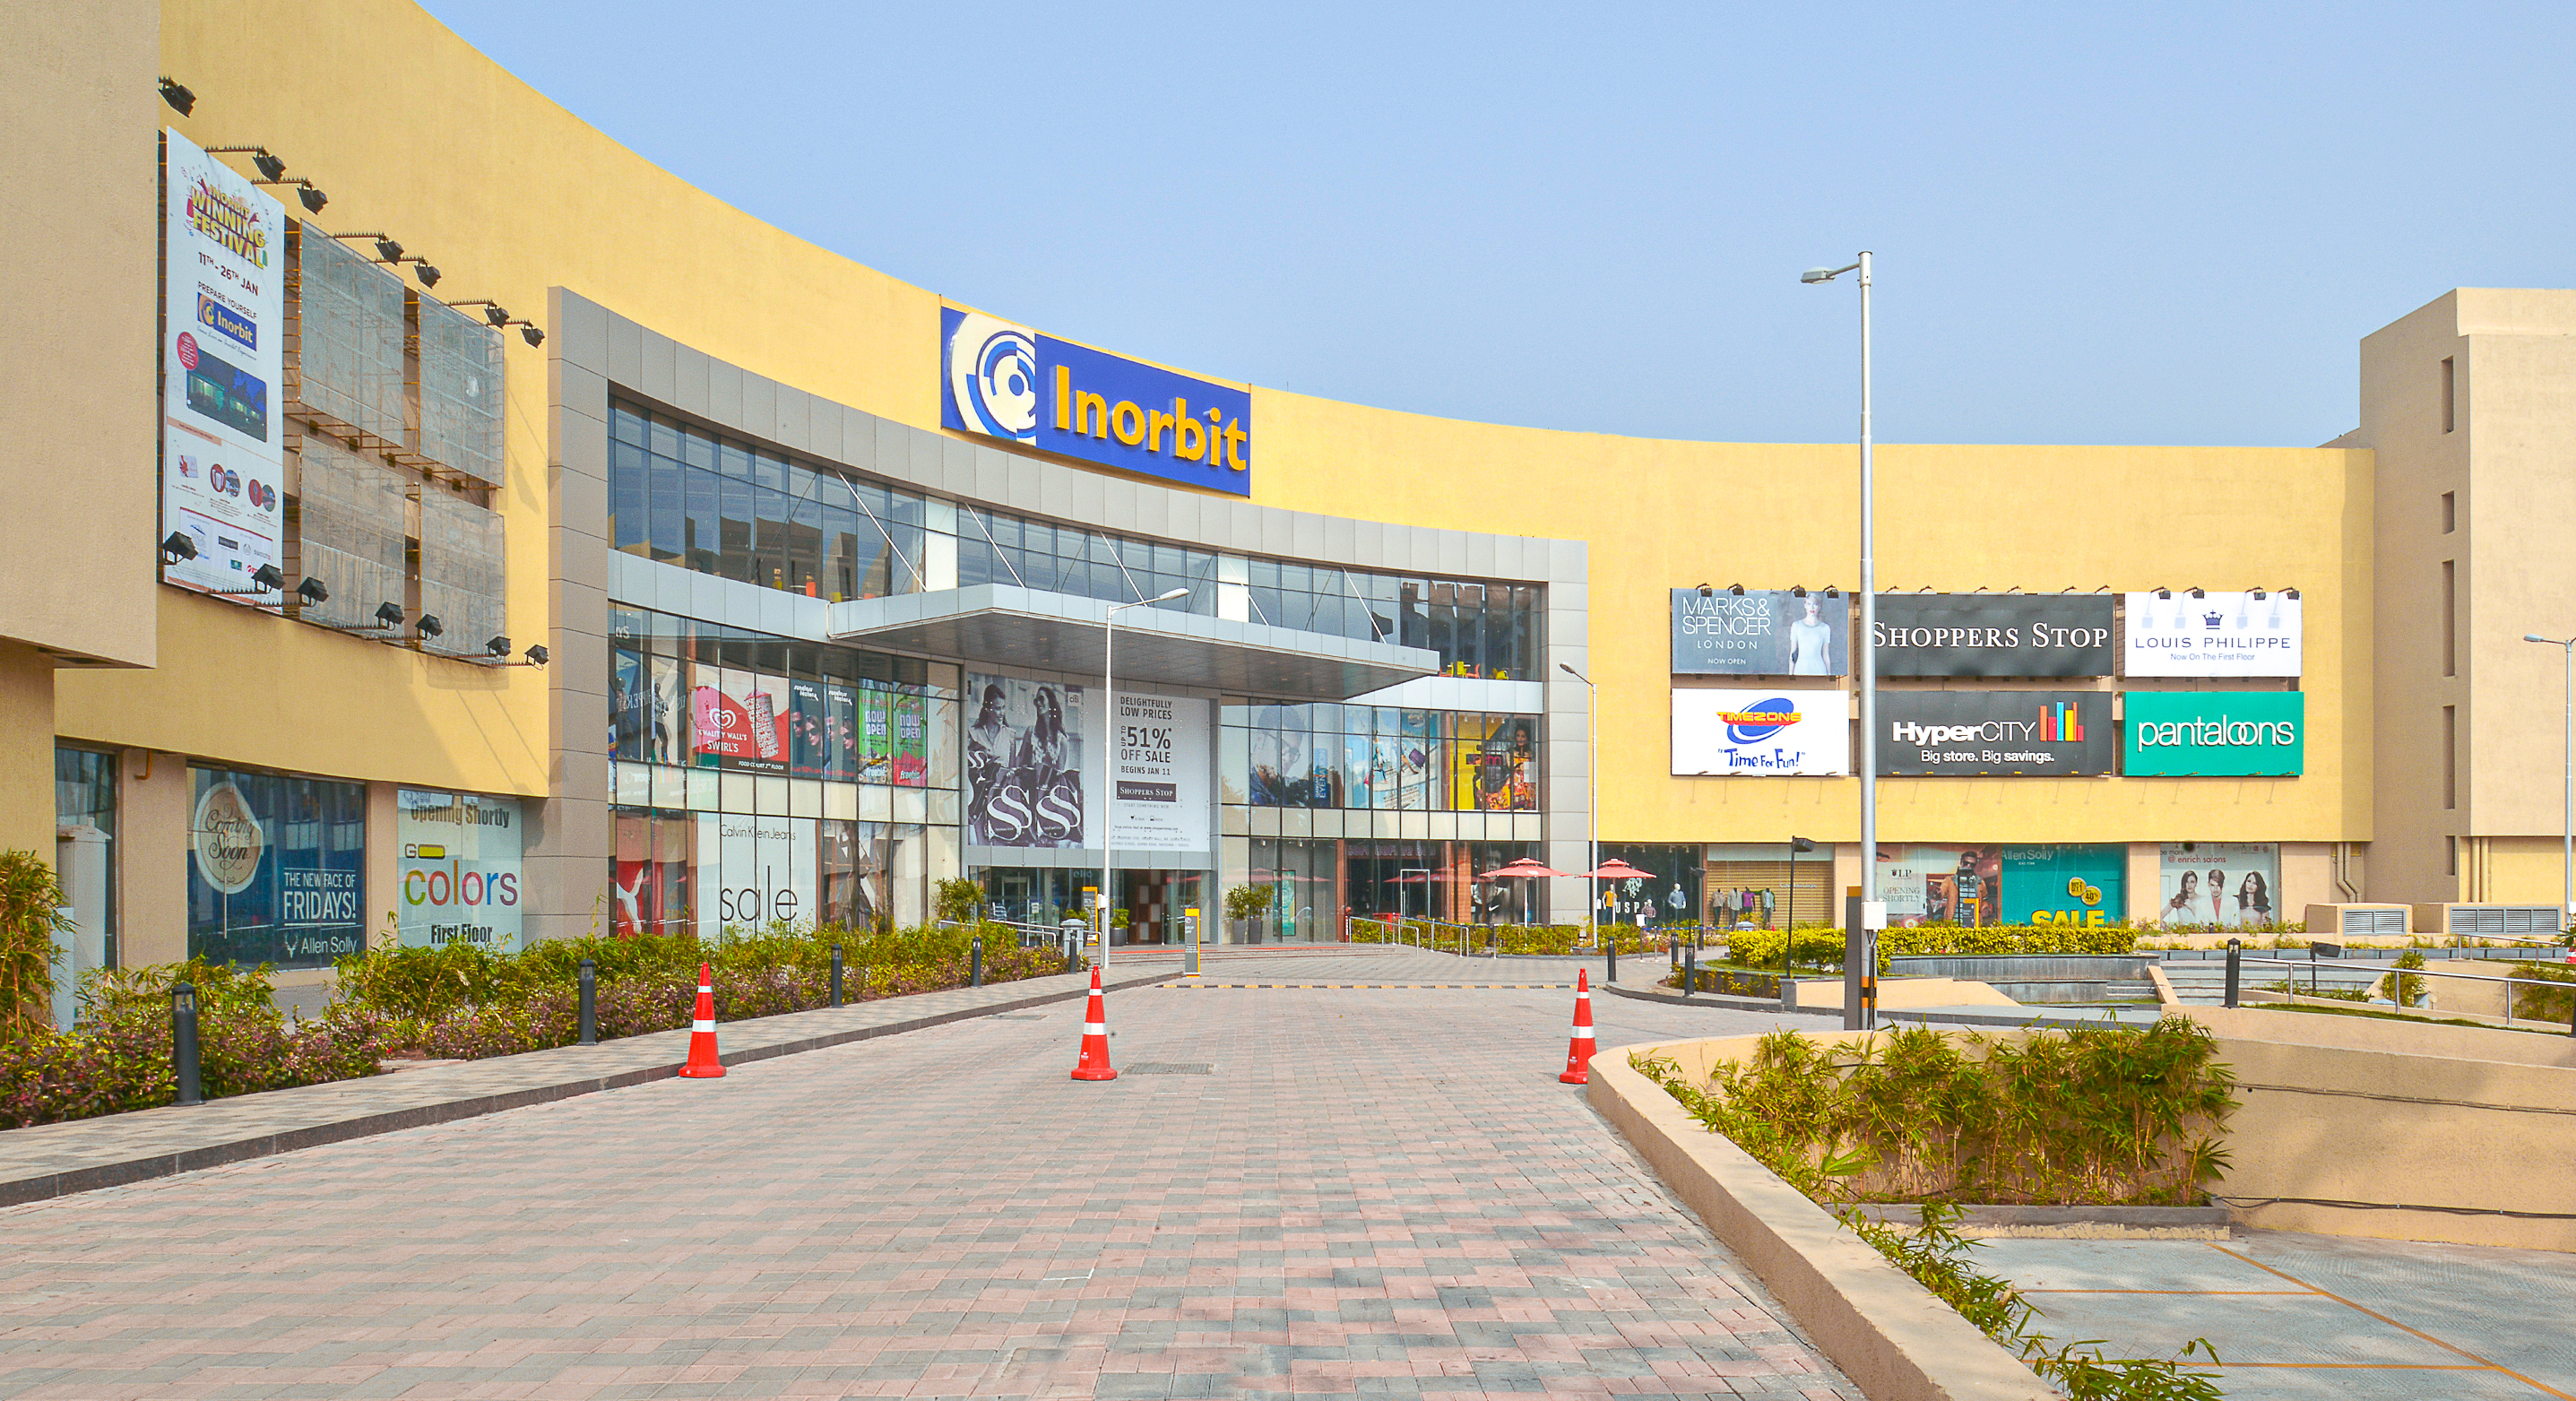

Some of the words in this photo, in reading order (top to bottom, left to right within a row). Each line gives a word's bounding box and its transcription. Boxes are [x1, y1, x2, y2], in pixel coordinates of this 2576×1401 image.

[191, 186, 265, 248] WINNING
[193, 207, 264, 270] FESTIVAL
[198, 252, 214, 265] 11TH
[220, 265, 239, 280] 26TH
[240, 278, 258, 296] JAN
[198, 281, 226, 303] PREPARE
[227, 297, 257, 320] YOURSELF
[217, 310, 253, 343] Inorbit
[1052, 364, 1247, 471] Inorbit
[1682, 616, 1771, 636] SPENCER
[2032, 622, 2108, 648] STOP
[2135, 637, 2192, 648] LOUIS
[2204, 637, 2291, 648] PHILIPPE
[1697, 640, 1758, 650] LONDON
[1120, 696, 1172, 709] DELIGHTFULLY
[1120, 706, 1139, 717] LOW
[1143, 708, 1172, 720] PRICES
[1716, 712, 1802, 723] TIMEZONE
[727, 732, 748, 740] WALL'S
[1120, 725, 1127, 734] TO
[1892, 721, 2036, 746] HyperCITY
[2138, 714, 2295, 753] pantaloons
[707, 740, 739, 753] SWIRL'S
[1120, 736, 1127, 747] UP
[1120, 748, 1141, 761] OFF
[1145, 751, 1171, 763] SALE
[1760, 756, 1775, 767] For
[1921, 750, 1941, 764] Big
[1942, 751, 1979, 762] store.
[1982, 750, 2001, 764] Big
[2003, 751, 2055, 764] savings.
[1120, 765, 1145, 774] BEGINS
[1155, 789, 1173, 797] STOP
[204, 809, 255, 844] Coming
[721, 824, 748, 837] Calvin
[748, 826, 770, 839] Kein
[209, 833, 248, 860] Soon
[2002, 850, 2026, 860] Allen
[2027, 849, 2054, 860] Solly
[2168, 855, 2176, 863] @
[2177, 854, 2201, 863] enrich
[2203, 855, 2226, 863] salons
[284, 872, 301, 887] THE
[303, 873, 322, 887] NEW
[324, 873, 343, 887] FACE
[345, 874, 357, 887] OF
[1898, 869, 1912, 877] LP
[404, 859, 518, 906] colors
[720, 865, 798, 921] sale
[1883, 886, 1920, 895] OPENING
[283, 891, 356, 920] FRIDAYS!
[1883, 895, 1920, 903] SHORTLY
[2031, 909, 2105, 929] SALE
[431, 924, 459, 944] First
[461, 924, 493, 943] Floor
[300, 937, 328, 954] Allen
[330, 936, 358, 956] Solly
